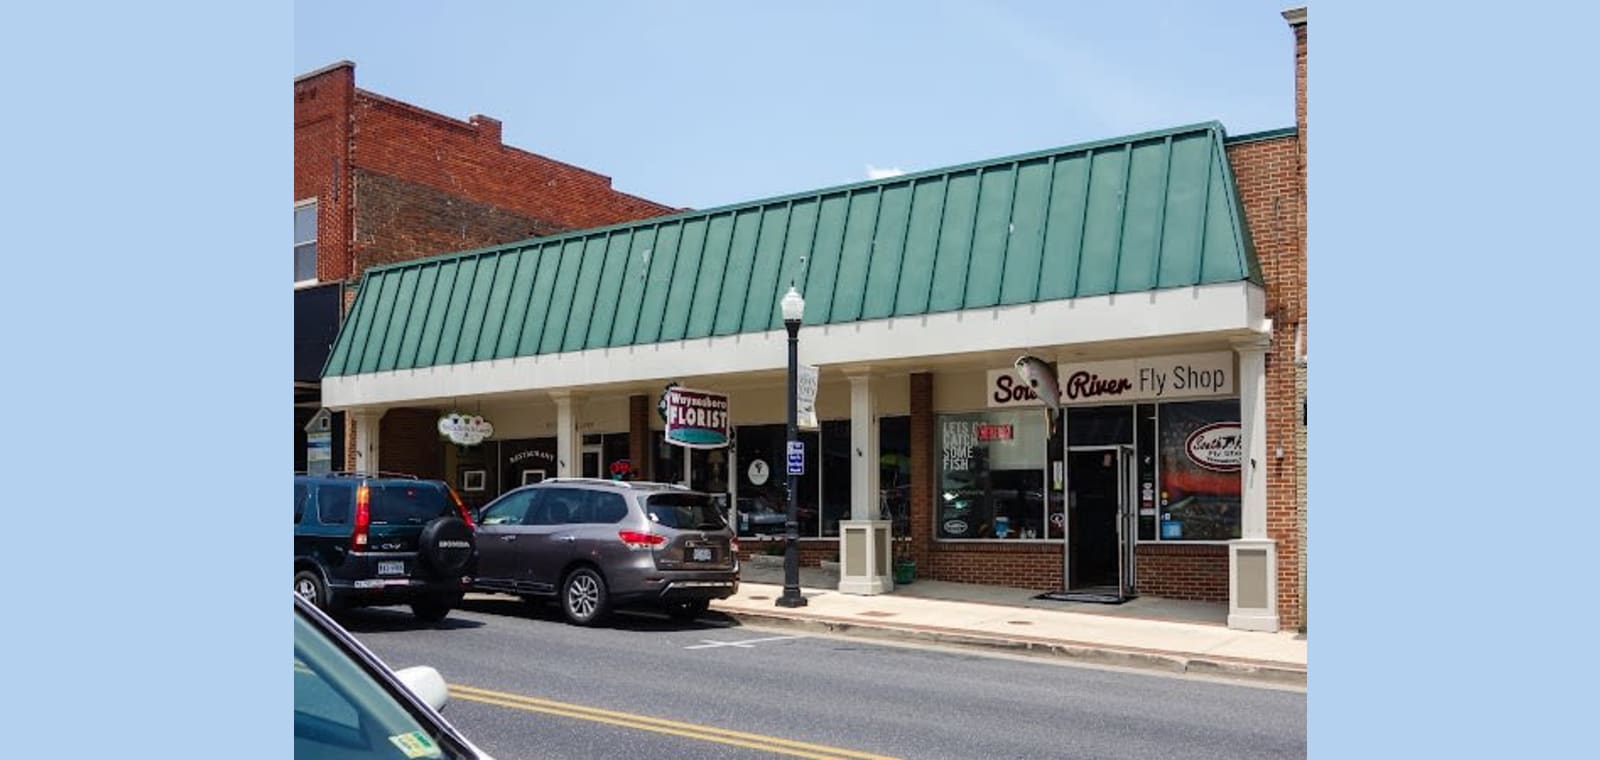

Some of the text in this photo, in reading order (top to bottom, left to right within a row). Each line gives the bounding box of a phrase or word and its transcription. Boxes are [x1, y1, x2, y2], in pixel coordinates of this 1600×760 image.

[1066, 371, 1132, 399] River
[1139, 367, 1166, 396] Fly
[1172, 365, 1225, 392] Shop
[671, 393, 727, 409] Waynesboro
[670, 405, 727, 428] FLORIST
[943, 421, 969, 433] LETS
[943, 432, 978, 446] CATCH
[508, 450, 555, 464] RESTAURANT
[943, 446, 974, 458] SOME
[943, 458, 969, 471] FISH
